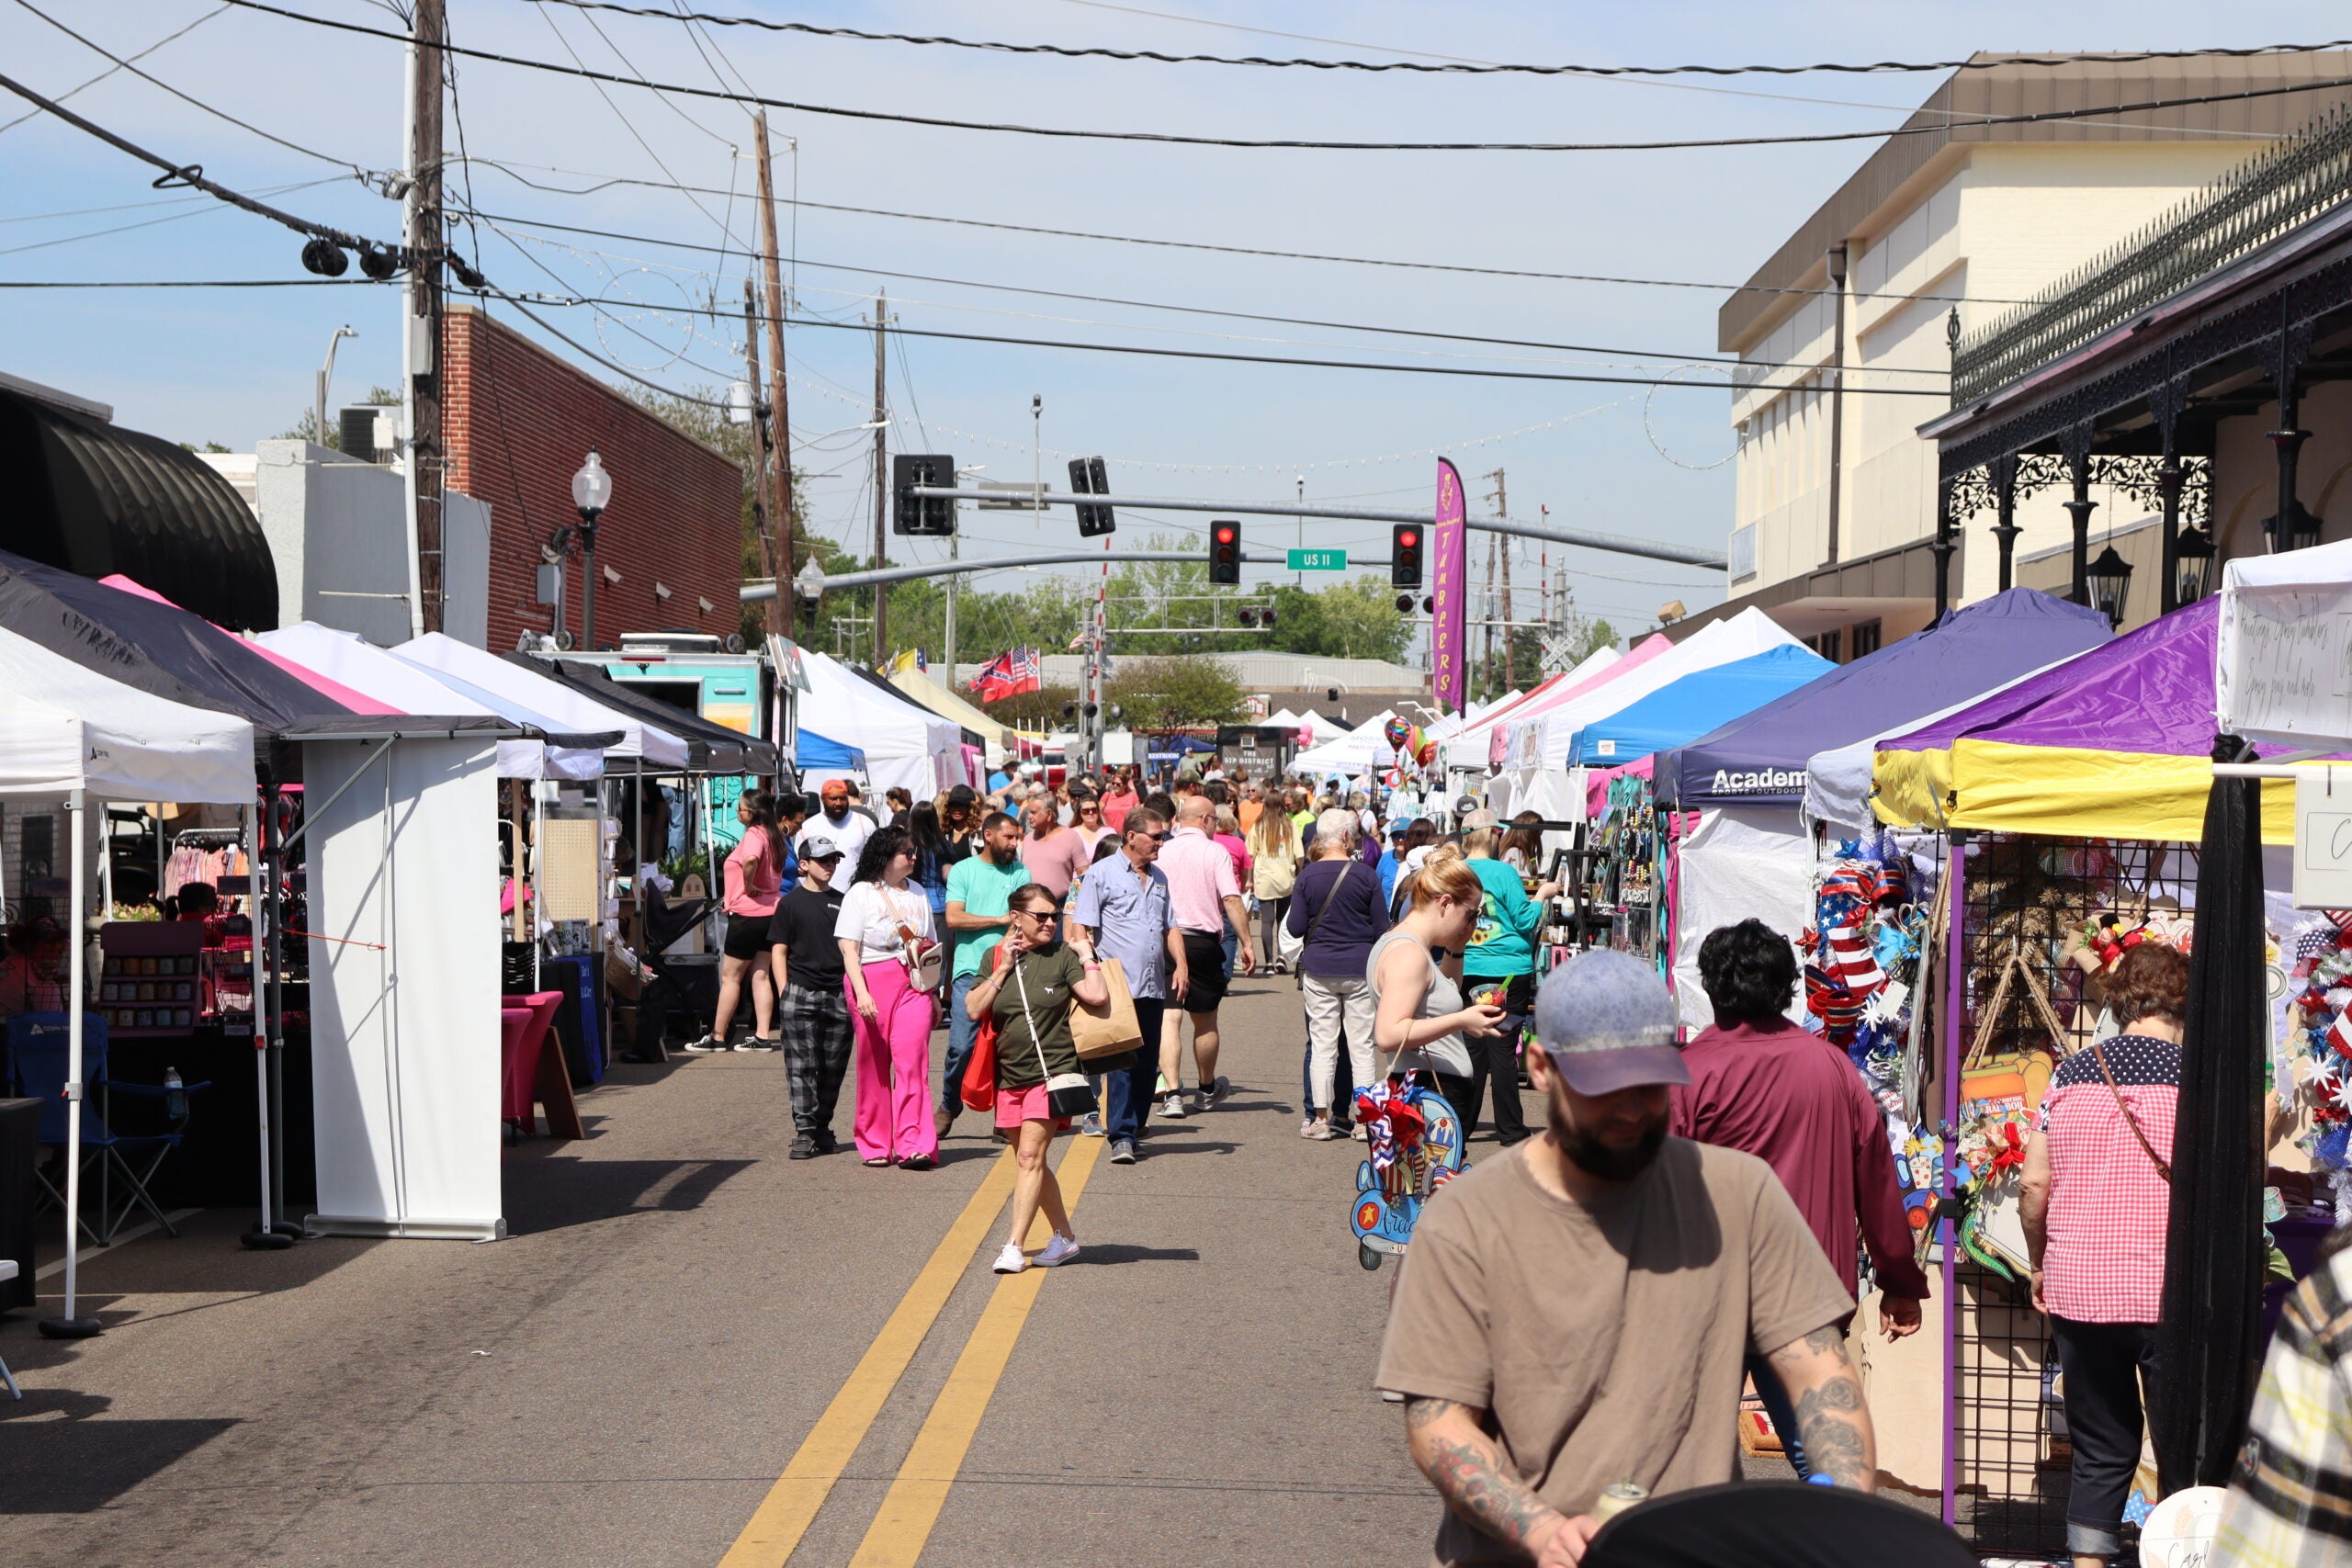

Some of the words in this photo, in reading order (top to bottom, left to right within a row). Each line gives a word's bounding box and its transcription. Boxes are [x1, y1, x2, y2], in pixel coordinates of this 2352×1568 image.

[1304, 554, 1321, 566] US
[1322, 554, 1330, 566] 11
[1437, 532, 1452, 692] TUMBLERS
[1542, 637, 1574, 668] CROSSING
[1543, 637, 1555, 651] RAIL
[1712, 767, 1807, 789] Academ
